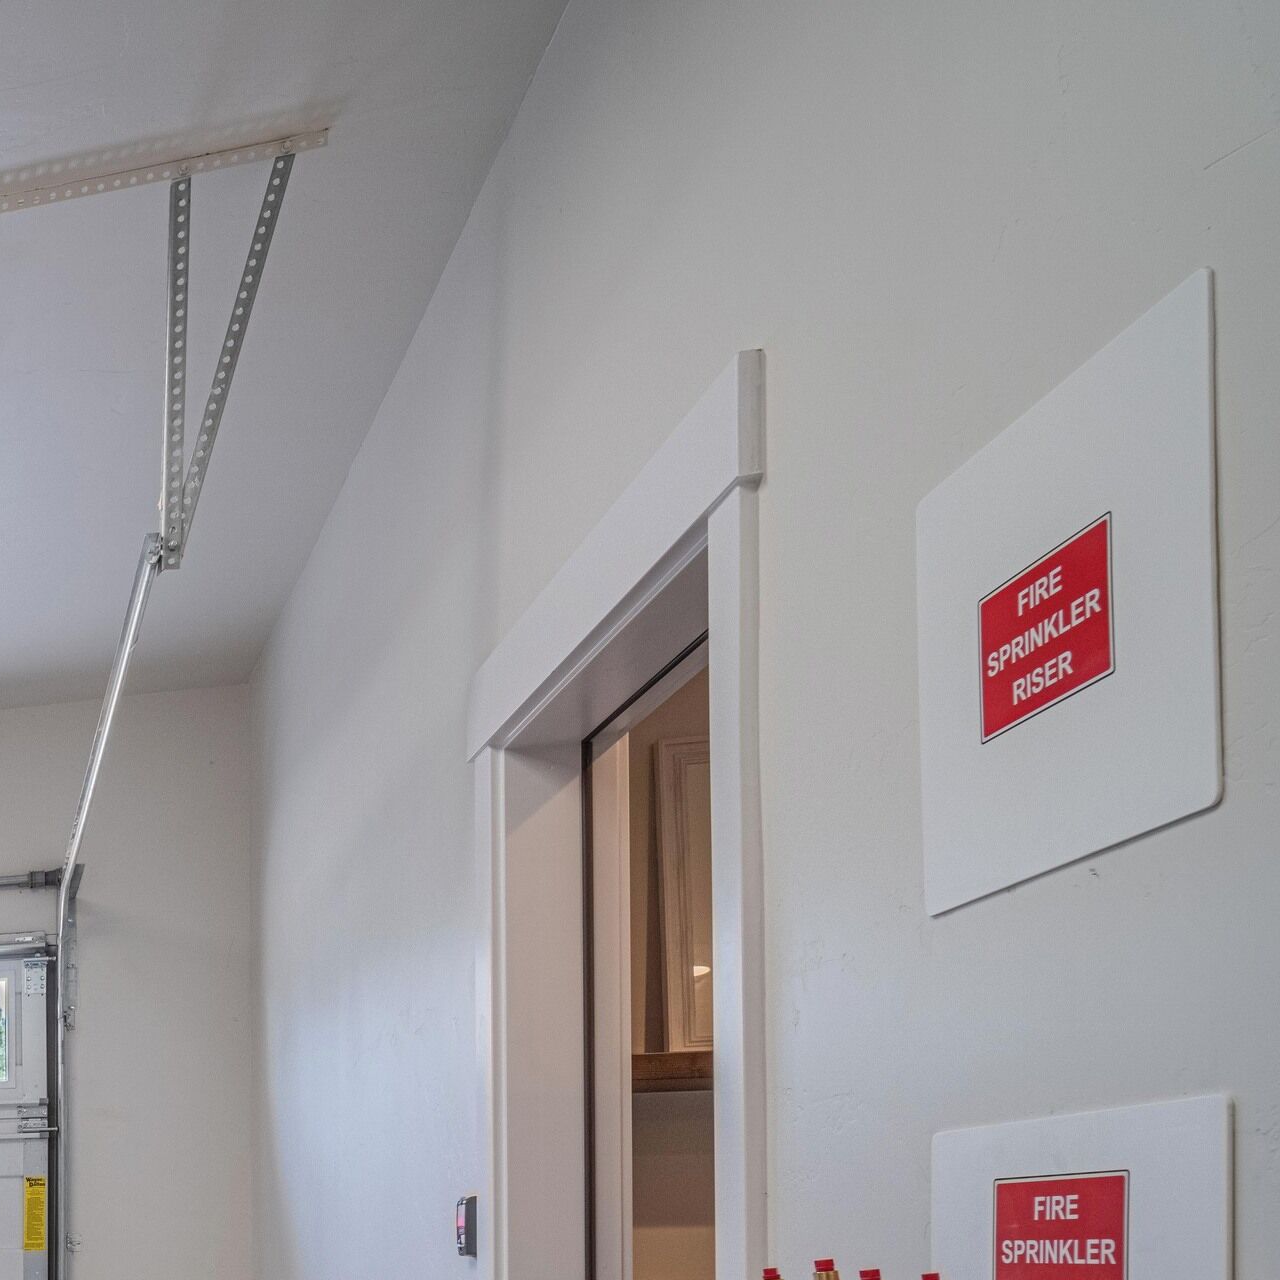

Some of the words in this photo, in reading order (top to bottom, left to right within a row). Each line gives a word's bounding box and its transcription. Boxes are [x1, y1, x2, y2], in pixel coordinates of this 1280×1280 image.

[1018, 566, 1062, 616] FIRE
[988, 588, 1101, 677] SPRINKLER
[1013, 651, 1073, 705] RISER
[1034, 1195, 1079, 1220] FIRE
[1001, 1239, 1117, 1265] SPRINKLER
